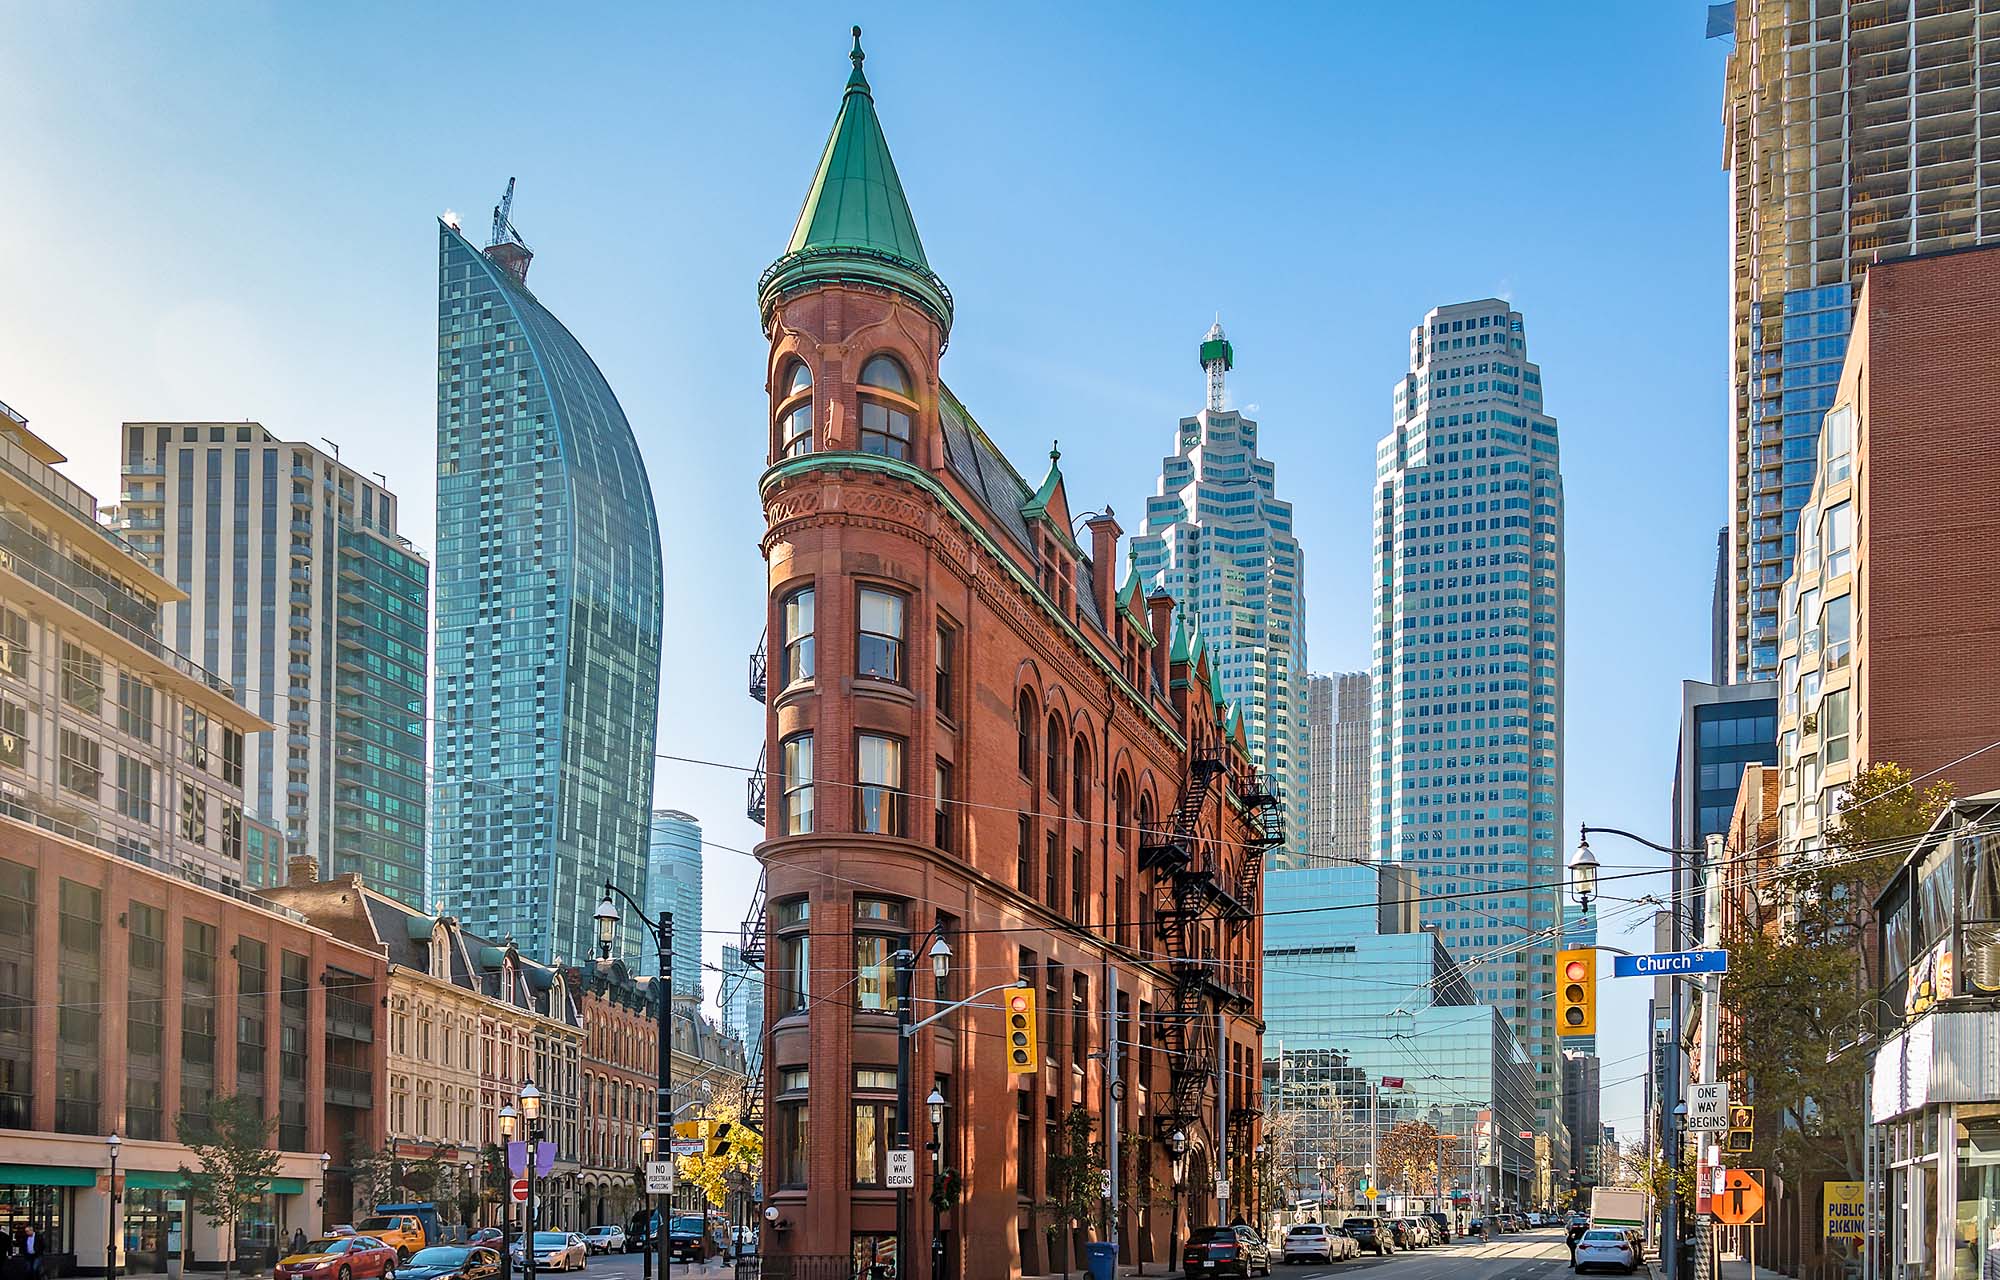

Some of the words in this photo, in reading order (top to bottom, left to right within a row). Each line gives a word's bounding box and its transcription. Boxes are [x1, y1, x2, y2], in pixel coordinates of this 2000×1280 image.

[1636, 954, 1691, 971] Church
[1695, 953, 1704, 961] St
[1697, 1087, 1718, 1098] ONE
[1697, 1101, 1718, 1112] WAY
[1689, 1116, 1726, 1128] BEGINS
[893, 1153, 907, 1162] ONE
[655, 1164, 666, 1174] NO
[893, 1165, 907, 1173] WAY
[888, 1175, 912, 1184] BEGINS
[1829, 1203, 1864, 1216] PUBLIC
